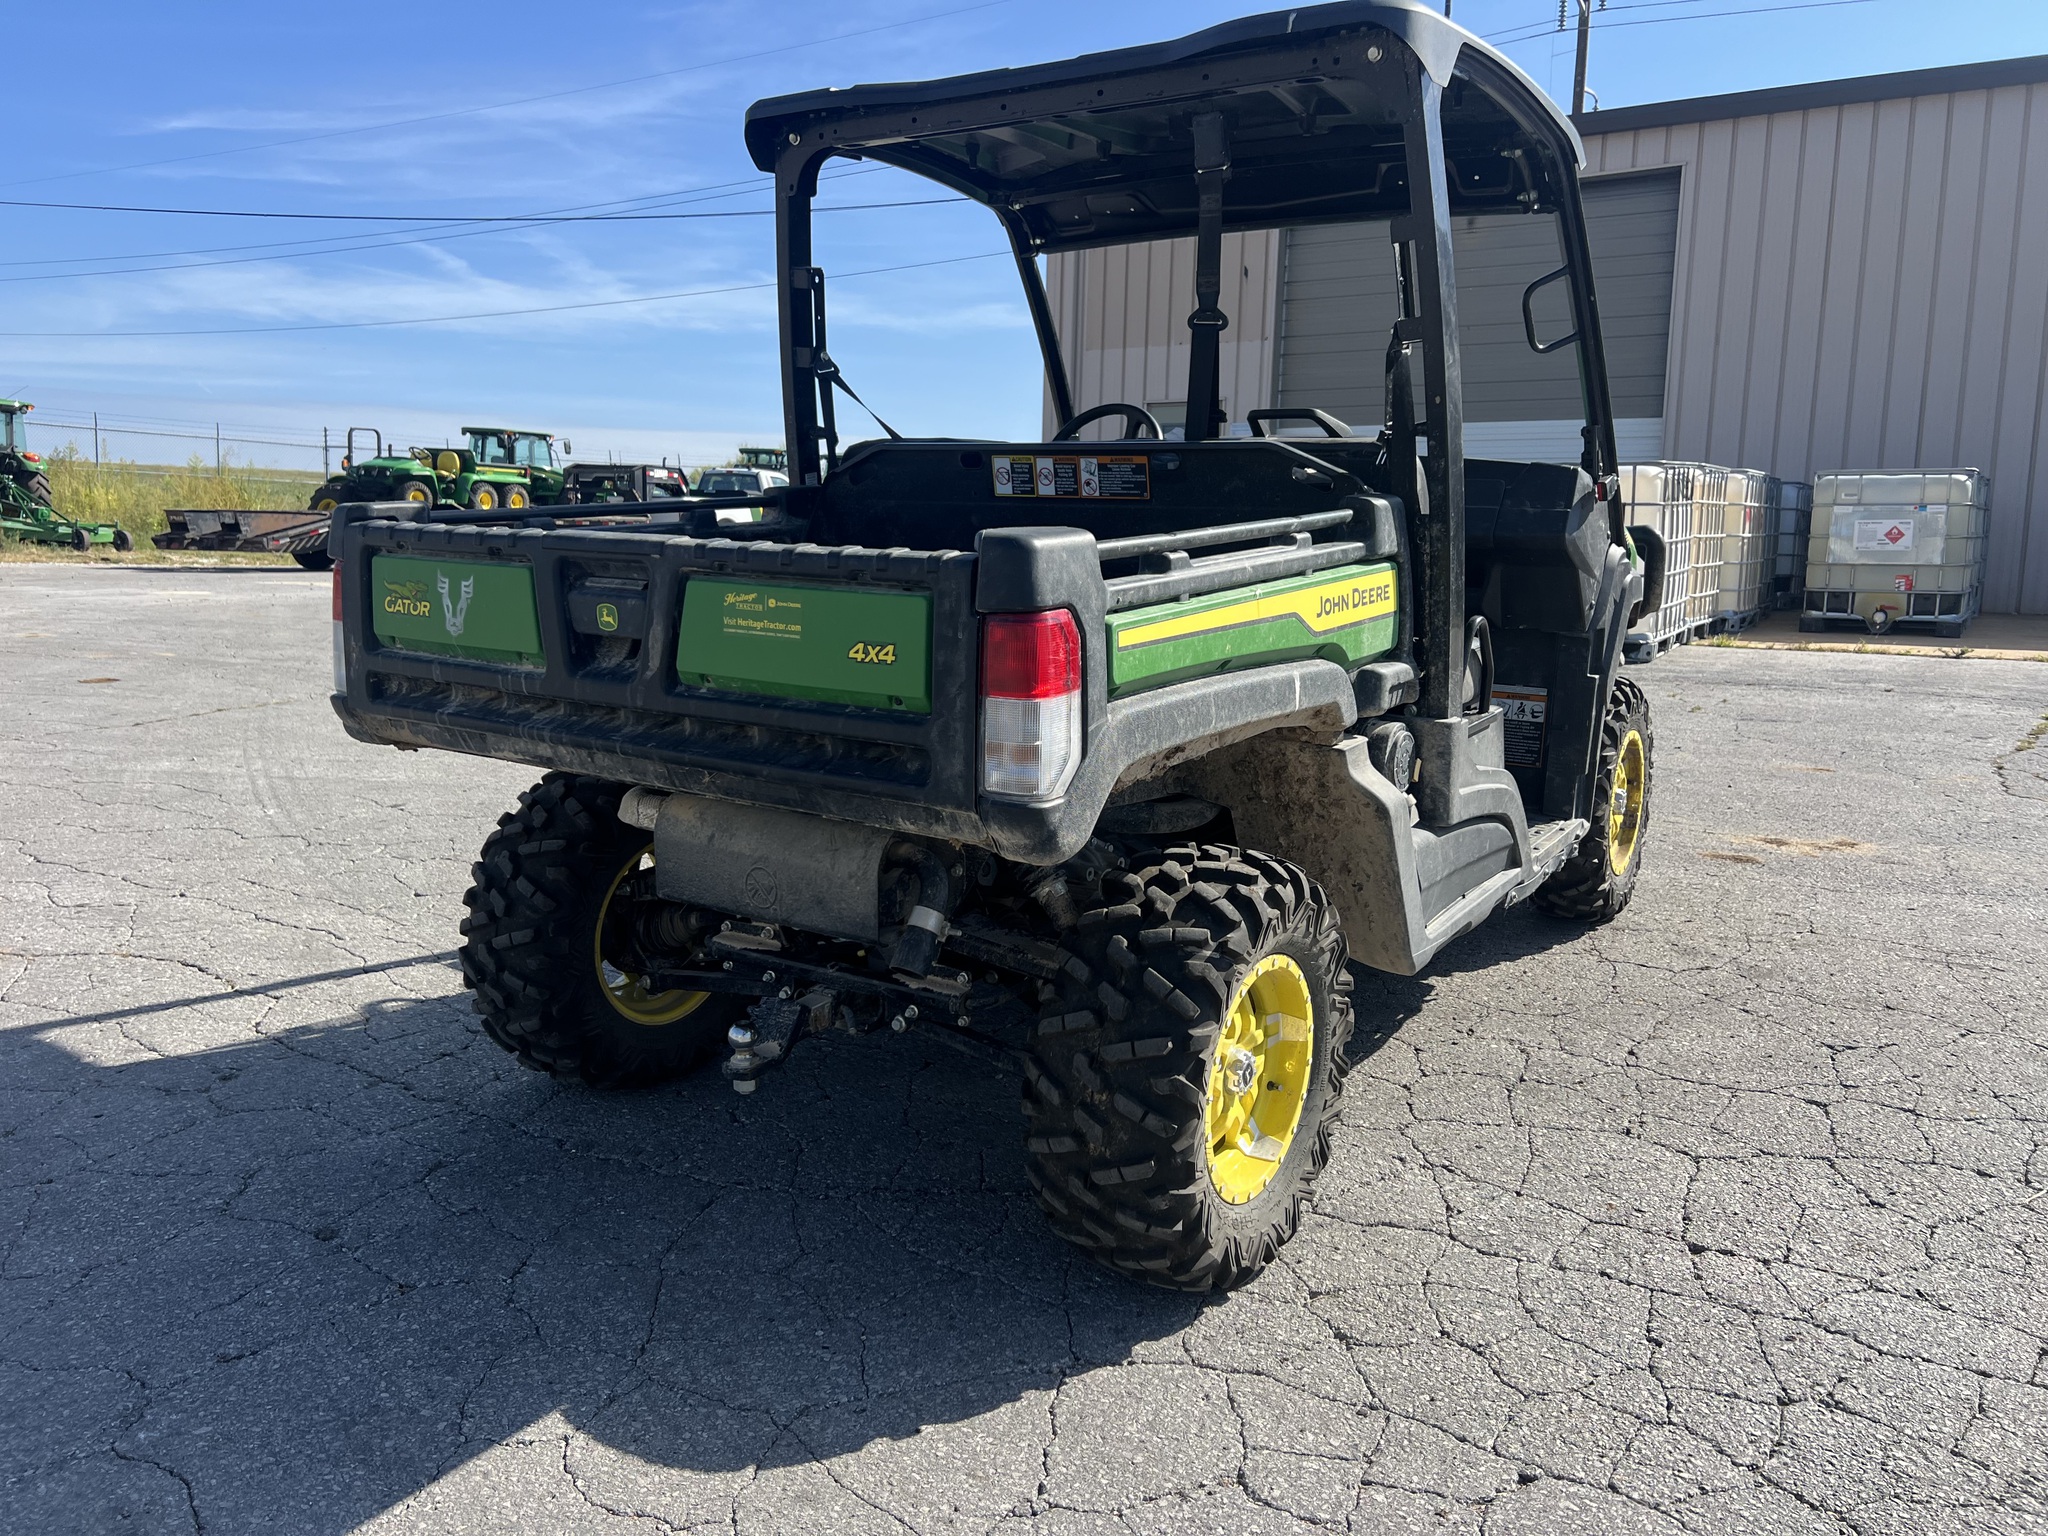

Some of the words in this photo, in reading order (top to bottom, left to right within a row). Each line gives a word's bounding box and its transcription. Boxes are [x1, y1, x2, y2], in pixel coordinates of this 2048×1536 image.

[384, 596, 431, 617] GATOR
[724, 592, 758, 605] Heritage
[1317, 594, 1349, 618] JOHN
[1353, 584, 1390, 608] DEERE
[723, 616, 737, 626] Visit
[738, 618, 802, 631] HeritageTractor.com
